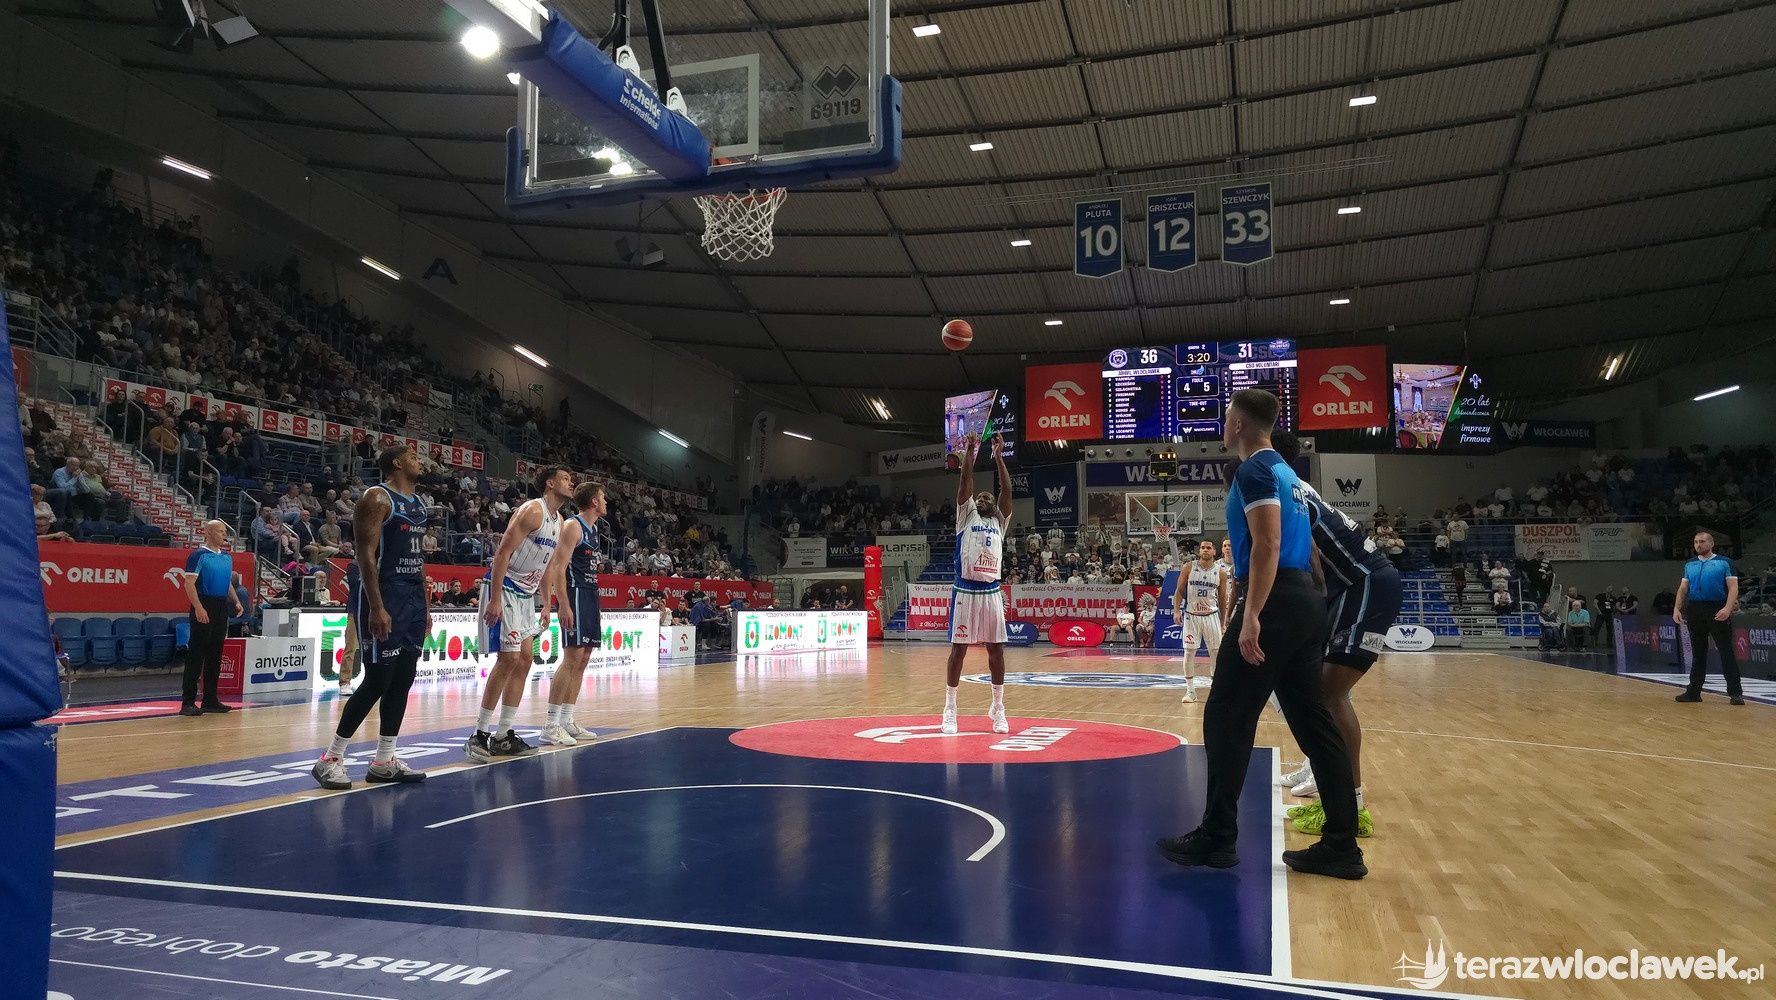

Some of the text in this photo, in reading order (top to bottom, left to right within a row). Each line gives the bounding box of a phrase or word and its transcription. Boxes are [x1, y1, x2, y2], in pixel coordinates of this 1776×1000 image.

[1222, 193, 1270, 205] SZEWCZYK
[1149, 201, 1194, 213] GRISZCZUK
[1085, 209, 1112, 219] PLUTA
[1224, 208, 1270, 245] 33
[1153, 217, 1190, 252] 12
[1080, 224, 1117, 258] 10
[1140, 349, 1158, 364] 36
[1238, 343, 1252, 358] 31
[1187, 353, 1210, 363] 3:20
[1183, 382, 1210, 393] 4 5
[1460, 395, 1490, 407] 20 lat
[1312, 400, 1374, 416] ORLEN
[1038, 414, 1091, 429] ORLEN
[1460, 423, 1491, 435] imprezy
[1533, 427, 1590, 438] WŁOCŁAWEK
[1459, 434, 1491, 444] firmowe
[902, 452, 942, 464] WŁOCŁAWEK
[1329, 500, 1371, 508] WŁOCŁAWEK
[1038, 506, 1073, 516] WŁOCŁAWEK
[1522, 525, 1580, 537] DUSZPOL
[410, 537, 421, 550] 11
[985, 536, 992, 547] 6
[66, 566, 129, 584] ORLEN
[1047, 584, 1074, 593] Ojczyzna
[1075, 584, 1085, 593] jest
[1095, 586, 1120, 594] szczycie
[1197, 589, 1208, 598] 20
[1658, 625, 1677, 640] ORLEN
[1748, 628, 1776, 645] ORLEN
[289, 644, 306, 652] max
[255, 653, 307, 669] anvistar
[1750, 649, 1769, 663] VITAY
[989, 726, 1079, 752] ORLEN
[284, 949, 511, 985] Miasto
